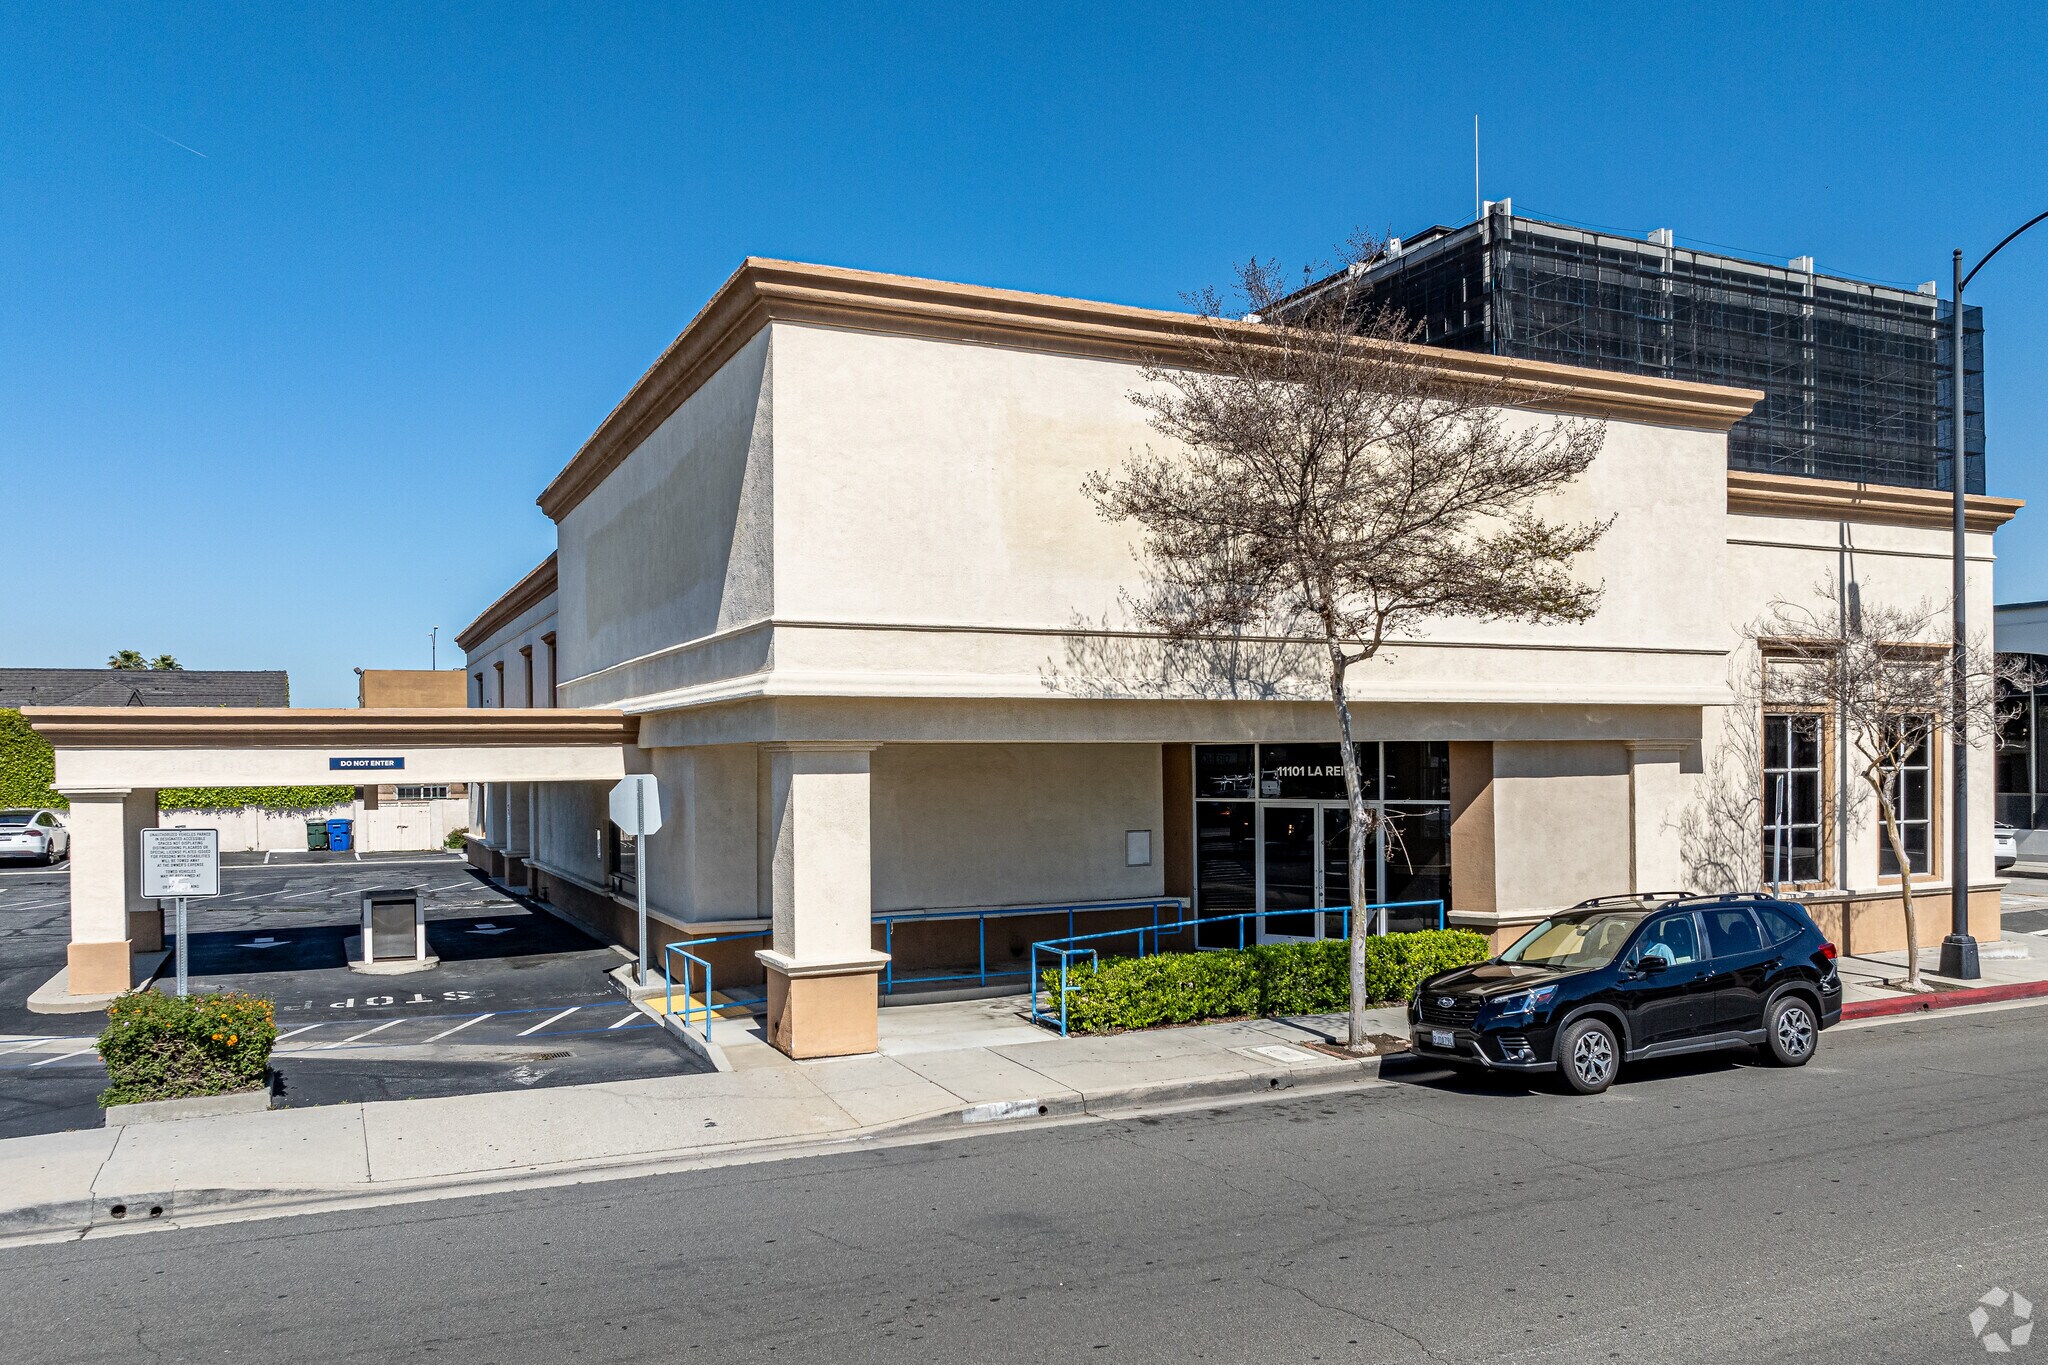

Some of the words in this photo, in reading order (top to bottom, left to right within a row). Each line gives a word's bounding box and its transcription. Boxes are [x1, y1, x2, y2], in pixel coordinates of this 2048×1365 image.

[1278, 766, 1305, 777] 11101
[1308, 766, 1323, 777] LA
[1326, 766, 1362, 777] REIA
[330, 991, 471, 1008] STOP
